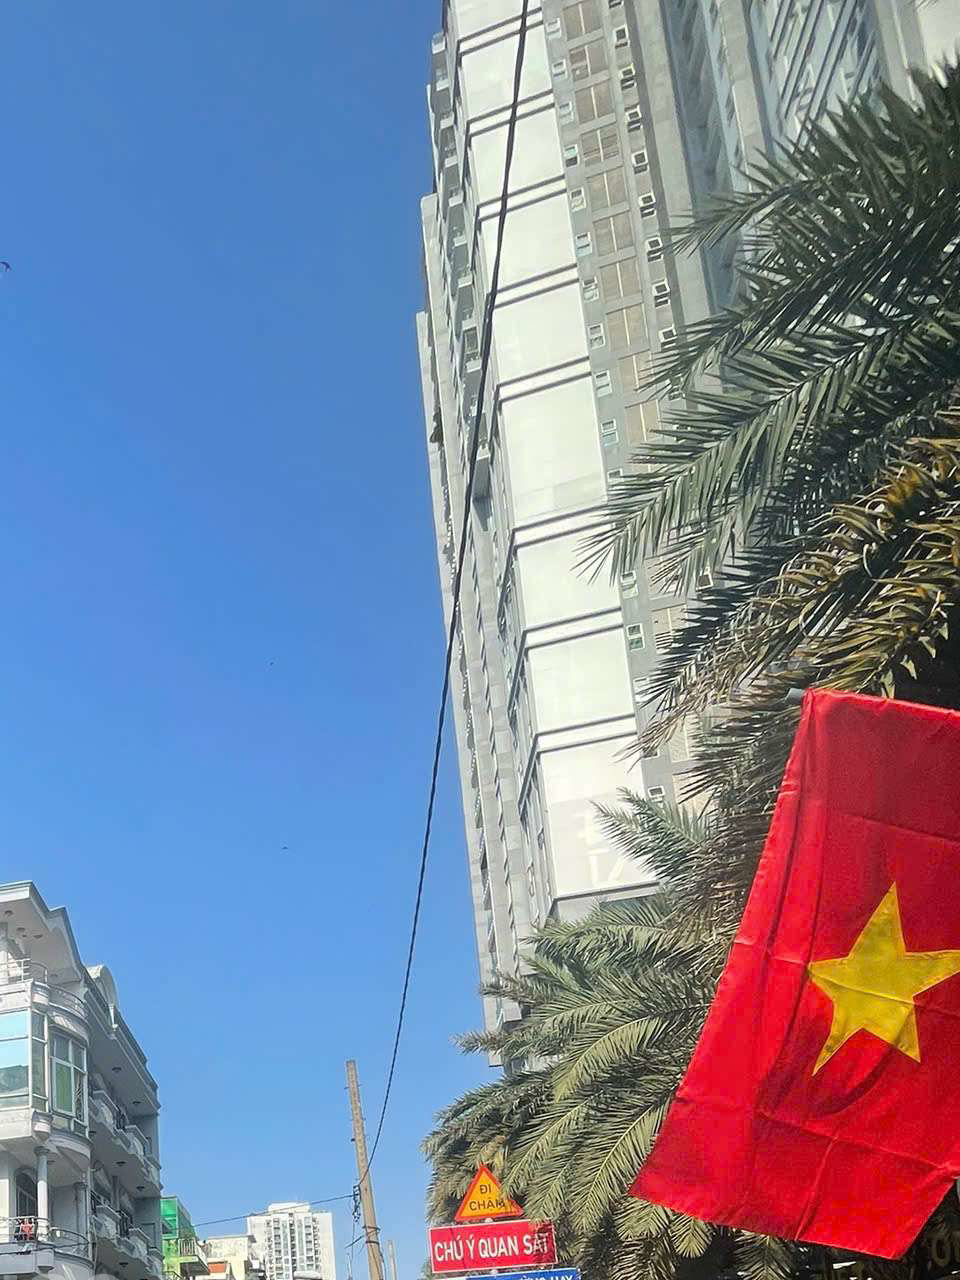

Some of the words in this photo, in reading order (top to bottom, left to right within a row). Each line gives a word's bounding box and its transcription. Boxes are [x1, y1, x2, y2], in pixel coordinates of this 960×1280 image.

[479, 1184, 492, 1194] ĐI
[434, 1235, 464, 1262] CHÚ
[465, 1234, 475, 1259] Ý
[478, 1236, 519, 1259] QUAN
